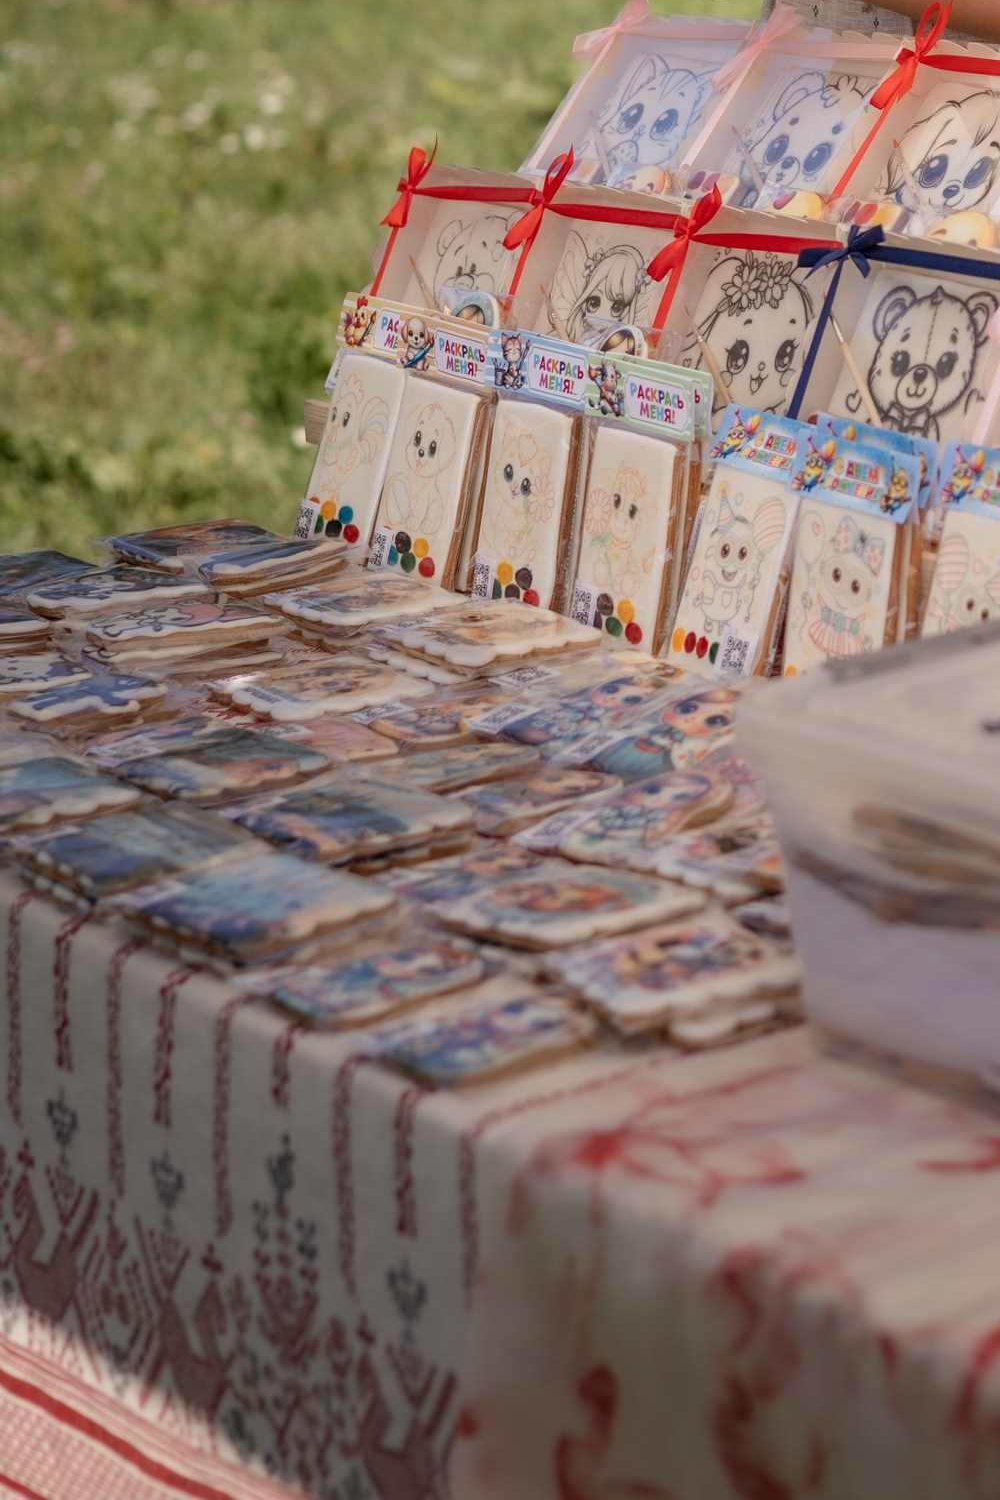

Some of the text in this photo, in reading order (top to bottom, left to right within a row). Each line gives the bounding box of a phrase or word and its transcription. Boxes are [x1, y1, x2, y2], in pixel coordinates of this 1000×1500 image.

[439, 338, 485, 363] РАСКРАСЬ
[446, 356, 478, 377] МЕНЯ!
[533, 354, 584, 380] РАСКРАСЬ
[539, 373, 575, 395] МЕНЯ!
[630, 381, 684, 409] РАСКРАСЬ
[639, 401, 675, 424] МЕНЯ!
[754, 430, 766, 447] С
[834, 457, 845, 475] С
